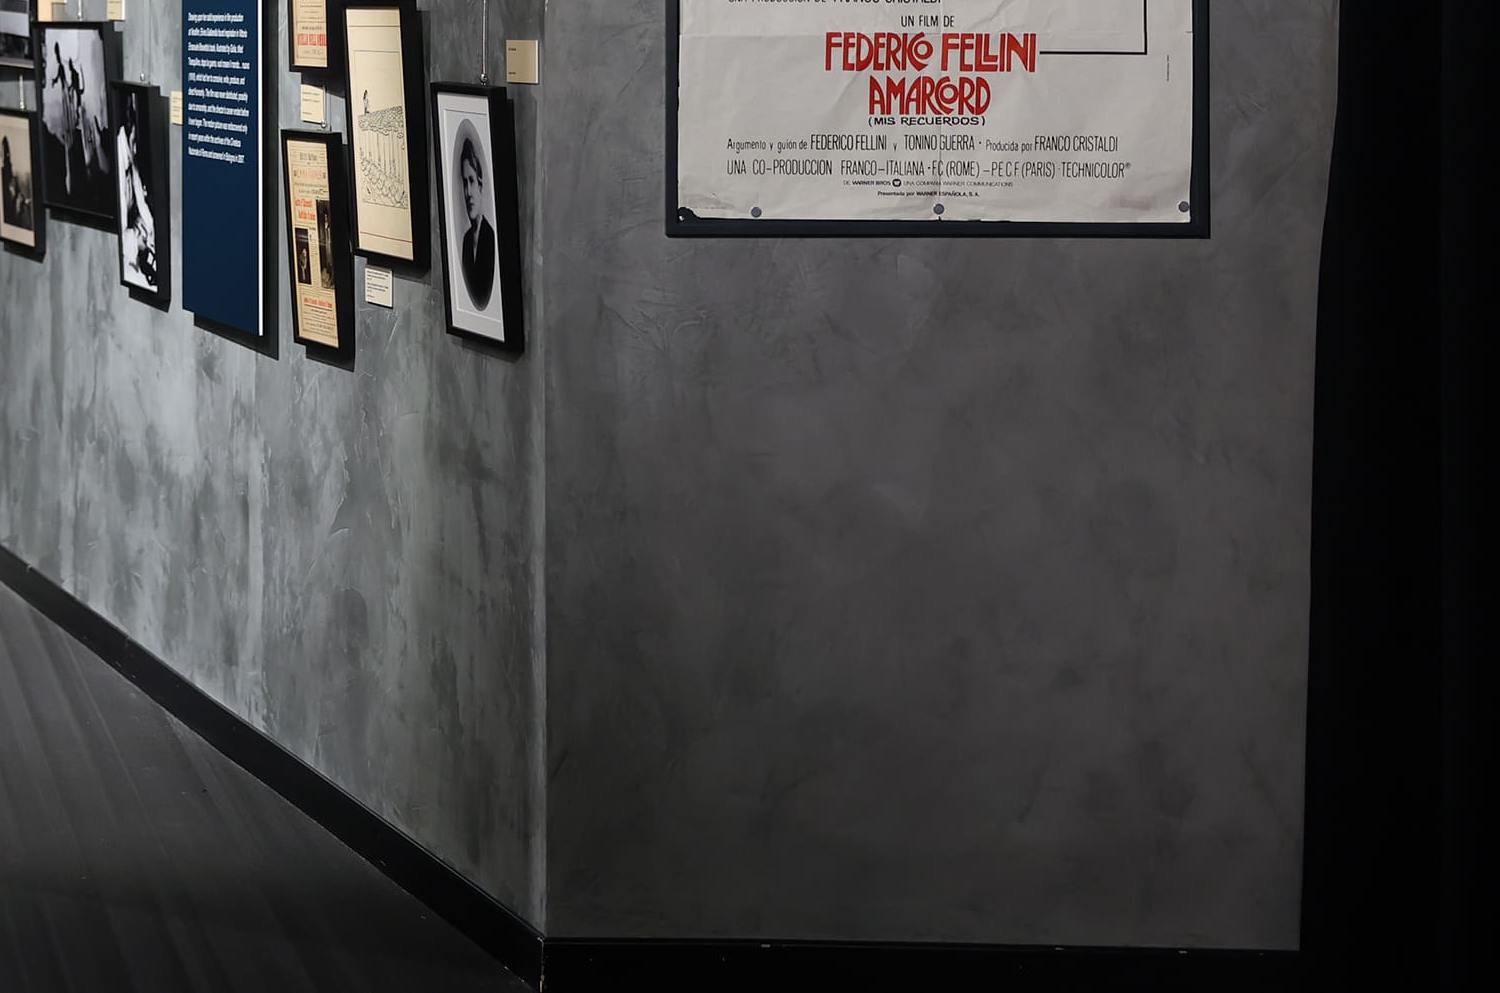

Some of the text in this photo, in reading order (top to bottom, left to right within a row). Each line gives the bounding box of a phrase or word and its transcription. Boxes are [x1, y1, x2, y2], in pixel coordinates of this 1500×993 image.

[900, 15, 955, 28] UN FILM DE
[825, 31, 1037, 73] FEDERICO FELLINI
[869, 74, 991, 116] AMARCORD
[868, 116, 986, 128] (MIS RECUERDOS)
[726, 137, 766, 154] Argumento
[769, 142, 774, 152] y
[798, 138, 808, 150] de
[810, 134, 854, 151] FEDERICO
[855, 134, 888, 151] FELLINI
[892, 142, 898, 152] y
[904, 134, 938, 151] TONINO
[940, 134, 976, 152] GUERRA
[986, 139, 1018, 152] Producida
[1021, 142, 1032, 154] por
[1034, 135, 1070, 152] FRANCO
[1072, 136, 1118, 152] CRISTALDI
[726, 159, 747, 176] UNA
[946, 160, 980, 178] (ROME)
[1021, 161, 1056, 179] (PARIS)
